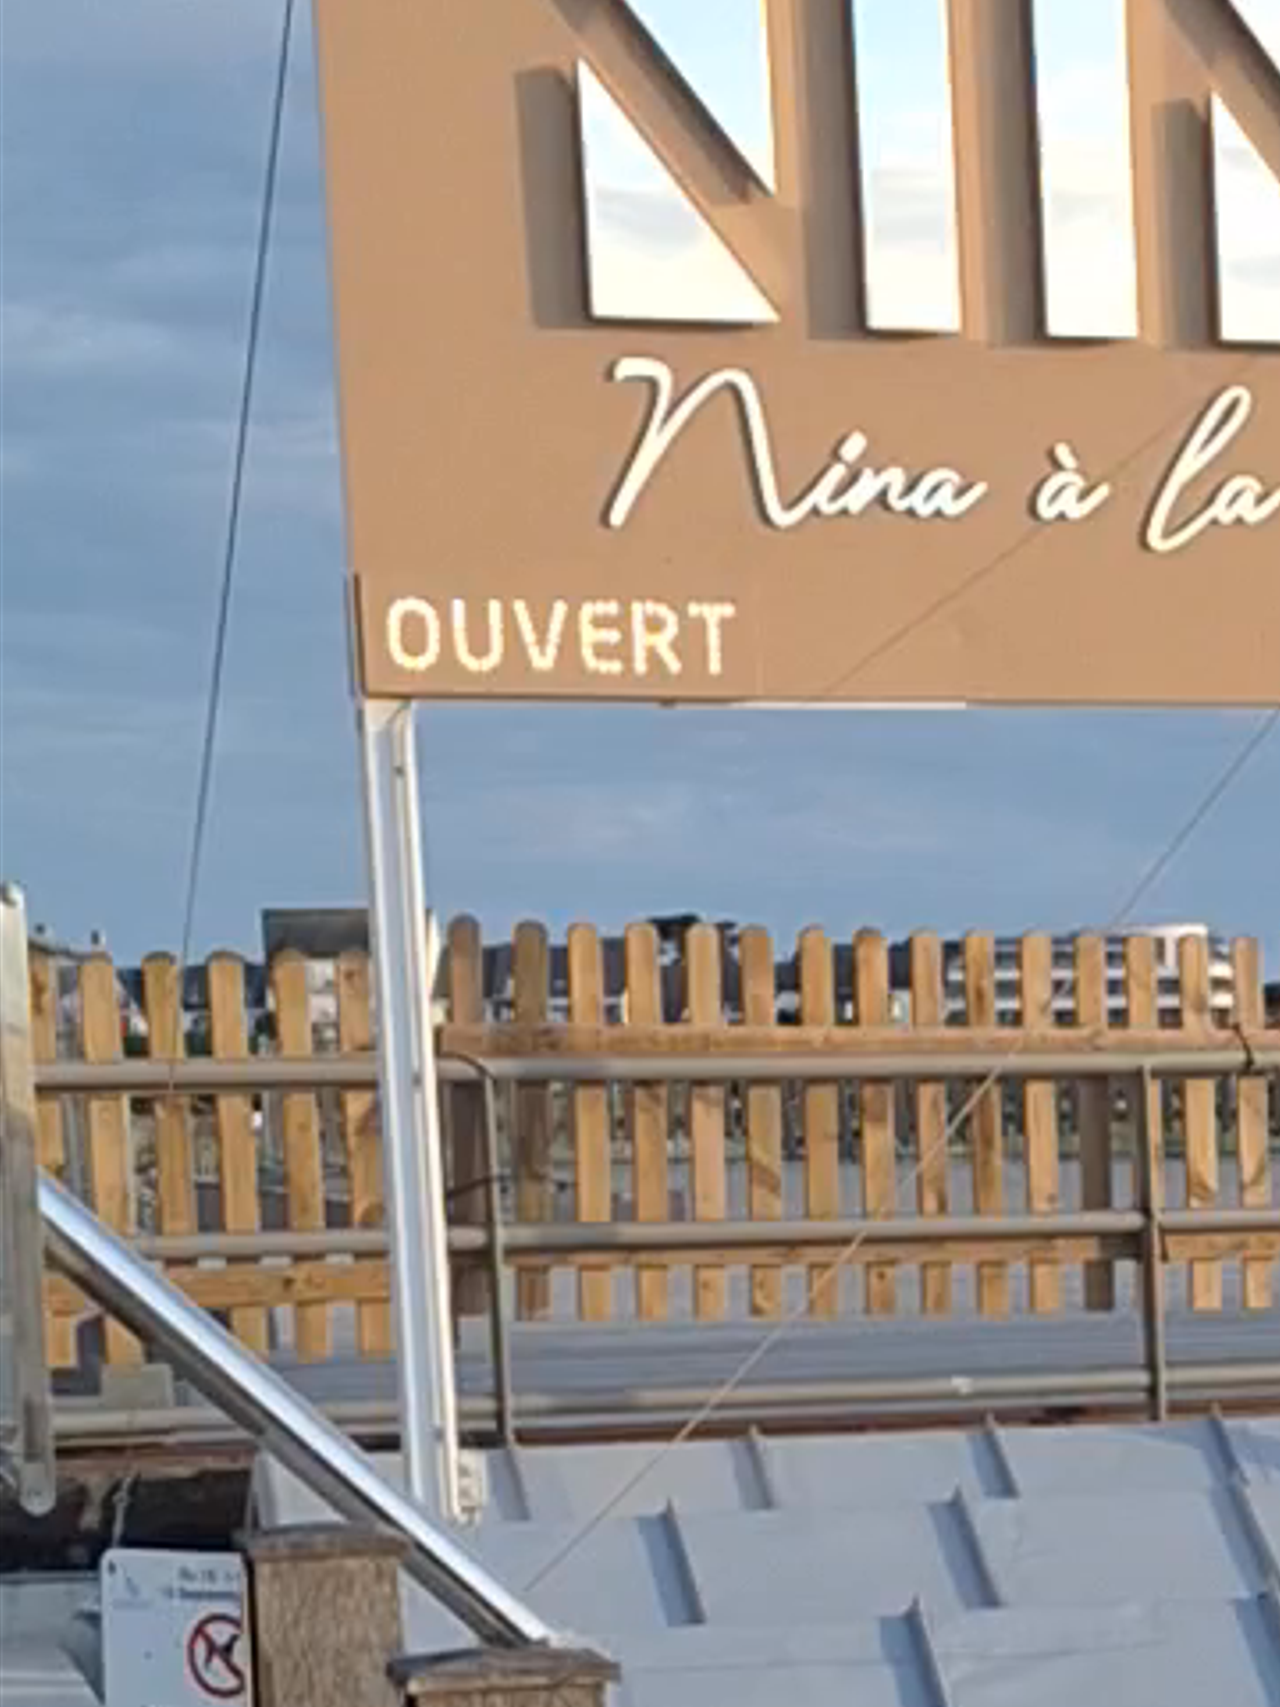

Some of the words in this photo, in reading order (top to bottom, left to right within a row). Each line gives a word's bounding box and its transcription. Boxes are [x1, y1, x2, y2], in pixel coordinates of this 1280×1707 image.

[604, 355, 988, 529] Nina
[1034, 442, 1110, 523] à
[386, 596, 736, 675] OUVERT
